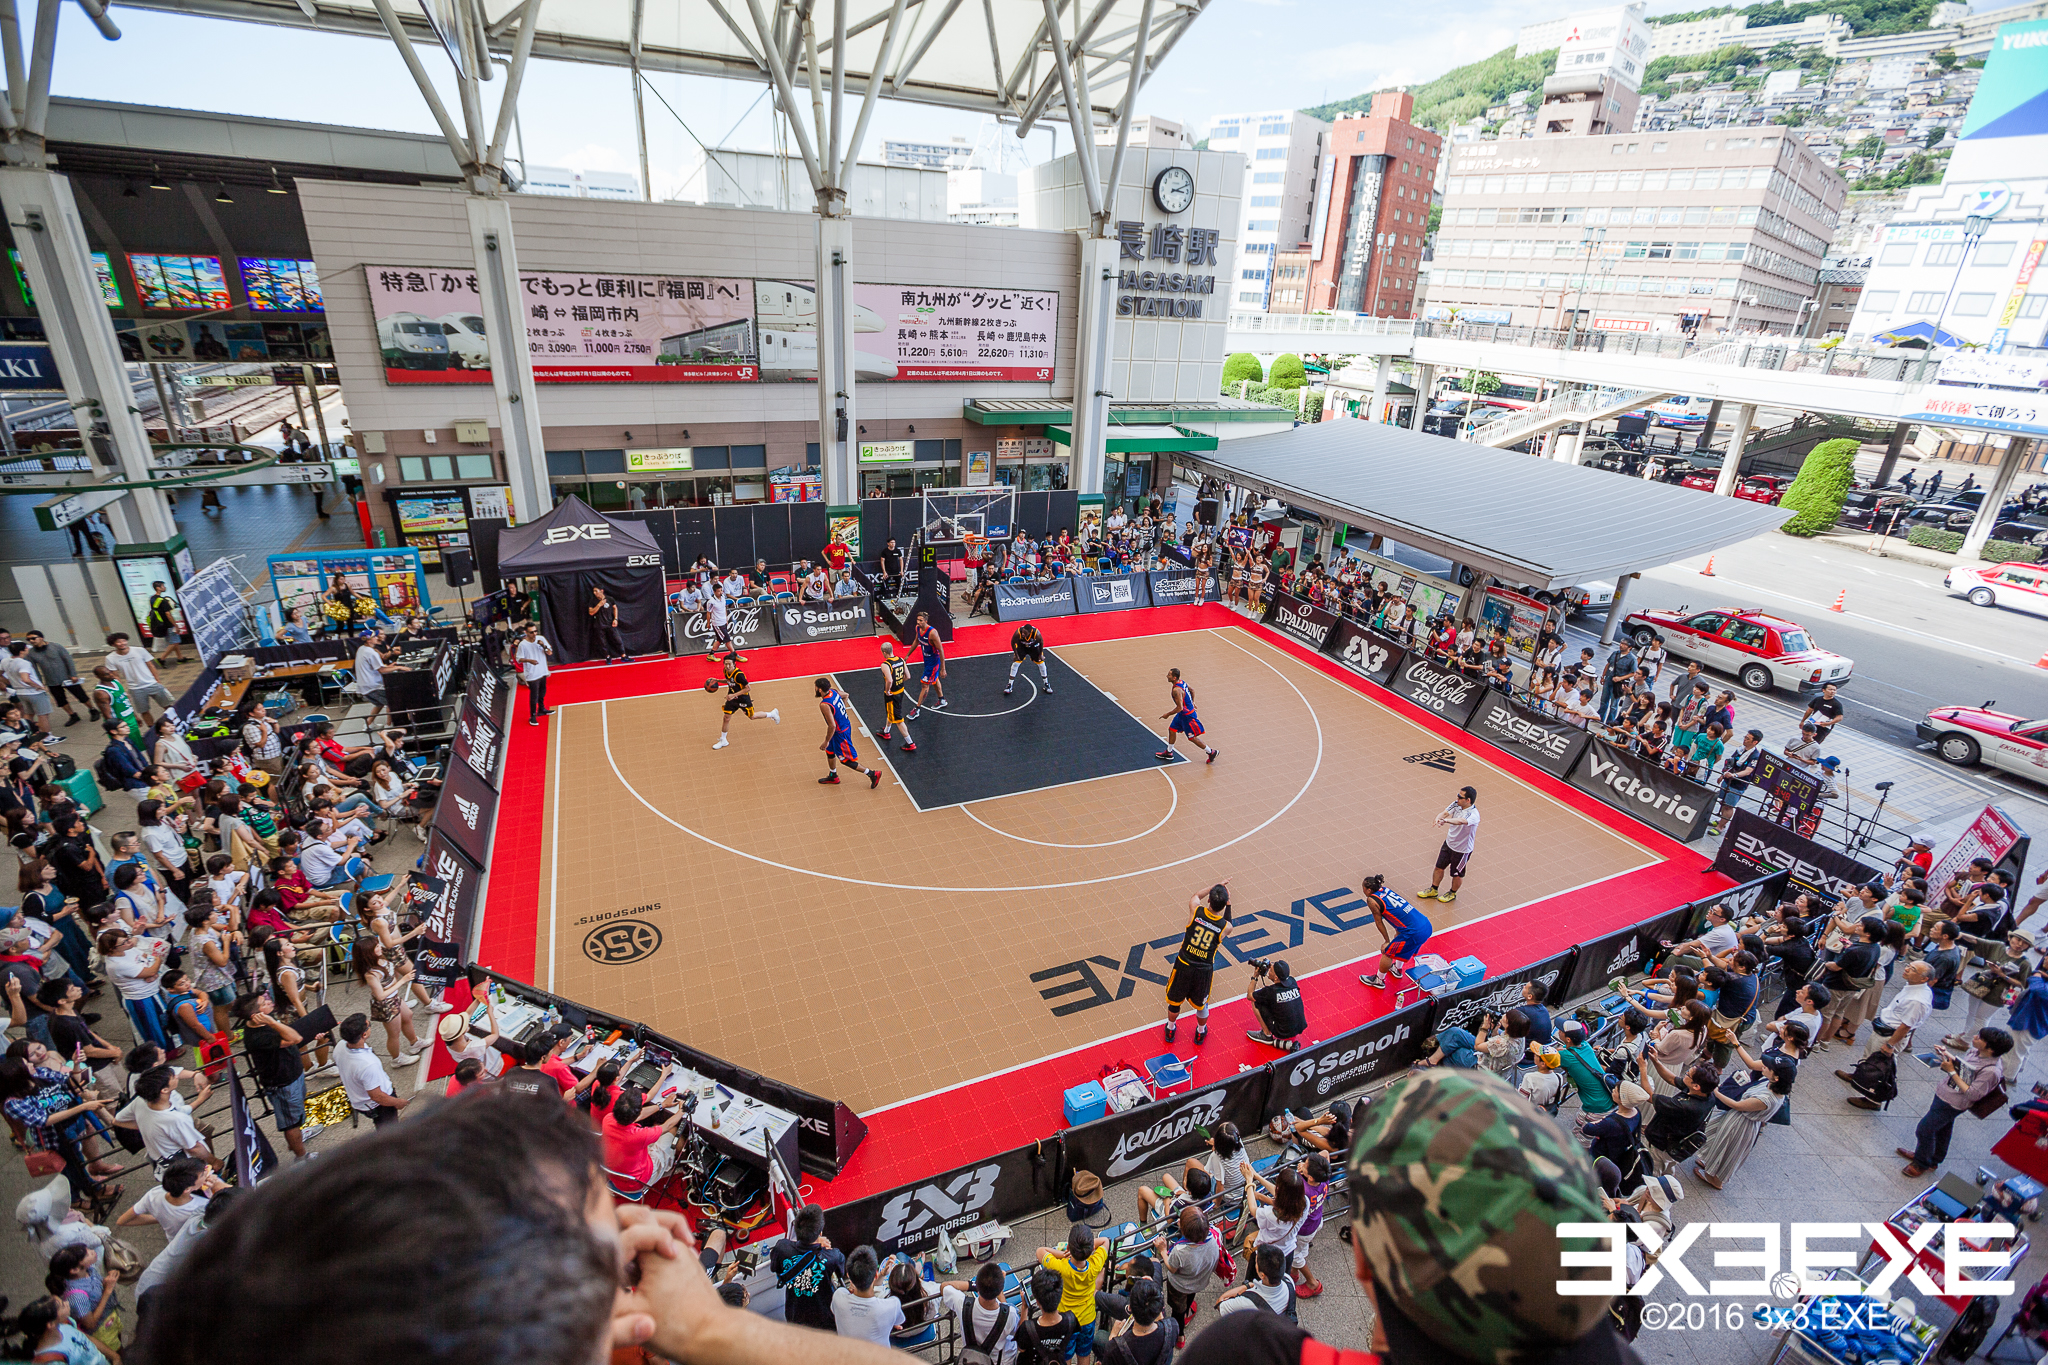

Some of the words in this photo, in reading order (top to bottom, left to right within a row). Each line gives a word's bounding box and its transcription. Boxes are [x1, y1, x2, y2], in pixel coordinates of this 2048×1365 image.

[1118, 221, 1219, 266] 長崎駅
[572, 305, 639, 323] 福岡市内
[1118, 296, 1202, 318] STATION
[938, 316, 1017, 328] 九州新幹線2枚きっぷ
[594, 328, 633, 337] 4枚きっぷ
[897, 329, 917, 340] 長崎
[929, 330, 949, 340] 熊本
[977, 331, 996, 342] 長崎
[1006, 332, 1047, 343] 鹿児島中央
[548, 343, 577, 353] 3,090円
[584, 343, 621, 353] 11,000円
[623, 344, 652, 354] 2,750円
[898, 347, 936, 357] 11,220円
[940, 348, 968, 358] 5,610円
[978, 348, 1015, 358] 22,620円
[1019, 349, 1049, 358] 11,310円
[737, 367, 753, 377] JR
[1036, 368, 1050, 376] JR
[1925, 399, 2037, 422] 新幹線で創ろう
[644, 453, 682, 461] きっぷうりば
[874, 445, 906, 453] きっぷうりば
[922, 548, 935, 563] 12
[1000, 592, 1071, 607] #3x3PremierEXE
[803, 605, 867, 624] Senoh
[1276, 606, 1328, 644] SPALDING
[1671, 632, 1686, 641] LUCKY
[1698, 641, 1710, 649] TAXI
[895, 666, 904, 680] 52
[476, 670, 498, 718] Victoria
[1484, 720, 1501, 731] PLAY
[1519, 737, 1542, 752] ENJOY
[467, 717, 496, 780] SPALDING
[1403, 748, 1455, 763] adidas
[2000, 743, 2032, 758] EKIMAE
[1765, 754, 1784, 768] CRAYON
[1589, 753, 1698, 824] Victoria
[1762, 763, 1775, 779] 9
[1780, 779, 1789, 789] 12
[1789, 780, 1812, 799] 20
[467, 802, 480, 831] adidas
[1729, 852, 1755, 867] PLAY
[410, 882, 439, 902] Crayon
[1387, 892, 1407, 908] 45
[580, 903, 662, 925] SNAPSPORTS
[1190, 926, 1215, 950] 39
[417, 949, 458, 969] Crayon
[1186, 945, 1208, 959] FUKUDA
[1607, 949, 1640, 975] adidas
[1317, 1024, 1411, 1075] Senoh
[1110, 1104, 1222, 1160] AQUARIUS
[898, 1231, 922, 1248] FIBA
[924, 1212, 980, 1239] ENDORSED
